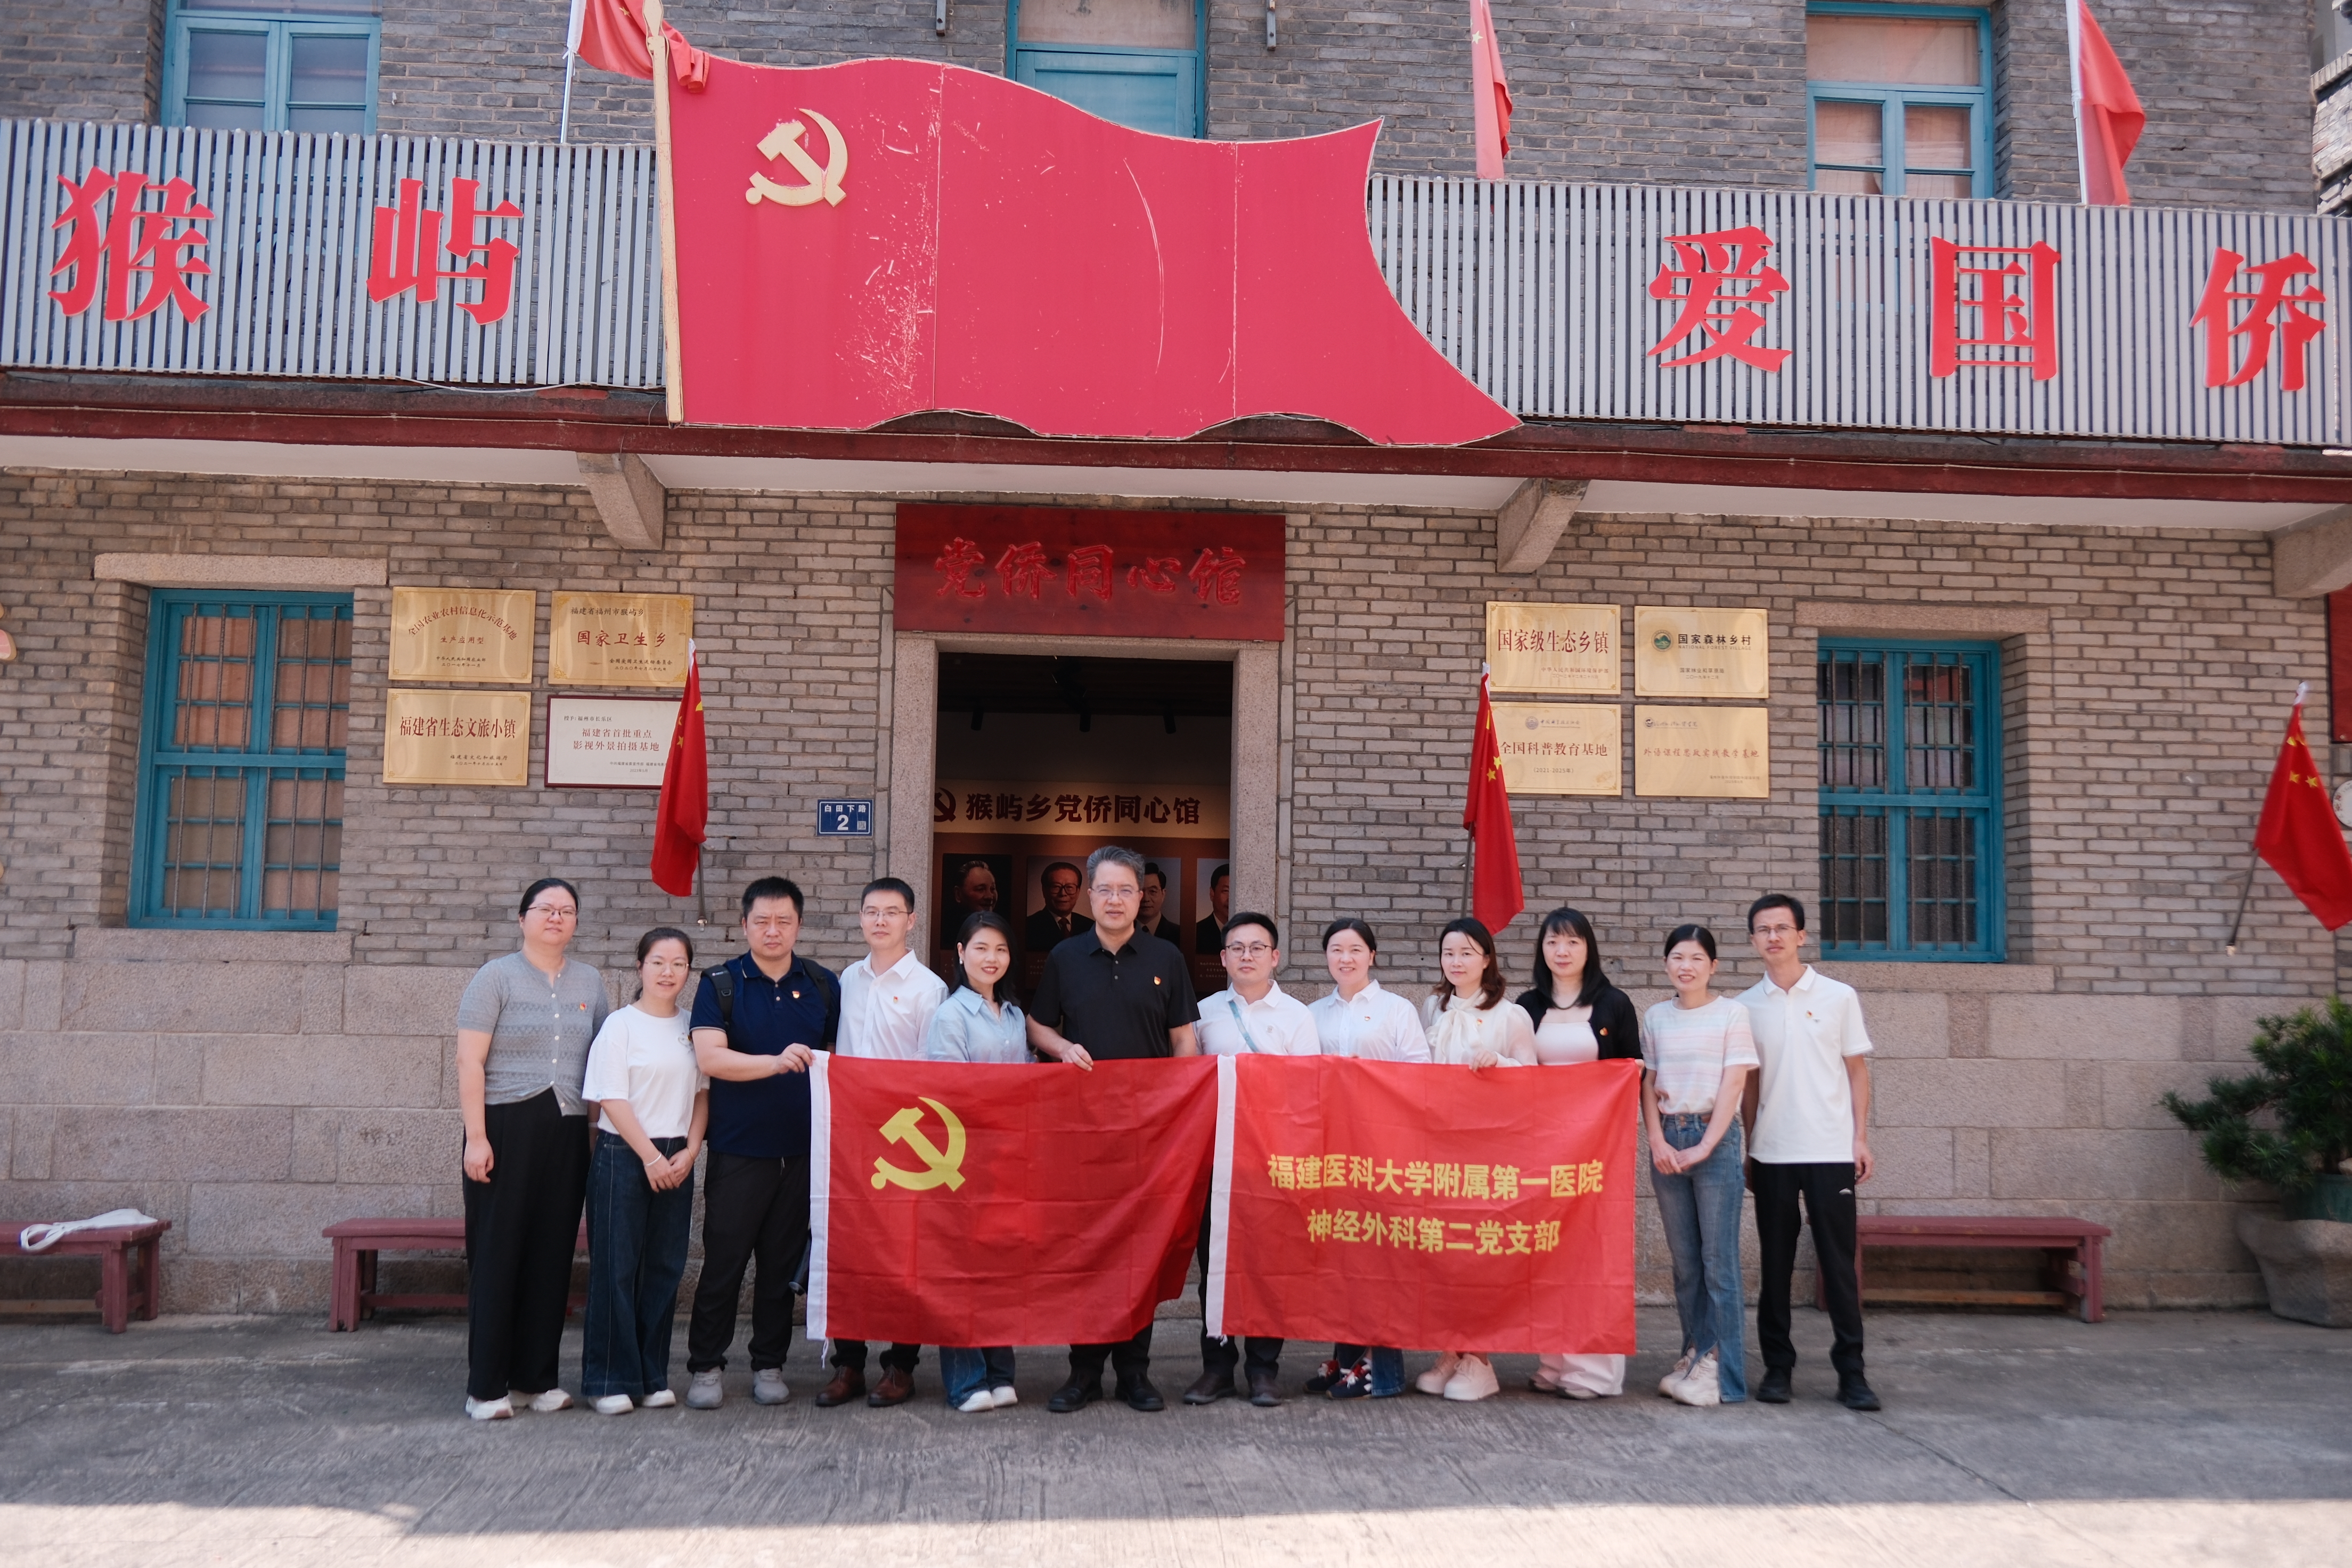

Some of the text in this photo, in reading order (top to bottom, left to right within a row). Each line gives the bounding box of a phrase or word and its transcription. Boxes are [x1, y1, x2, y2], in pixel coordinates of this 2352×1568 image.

[47, 167, 524, 325] 猴屿
[1647, 226, 2326, 391] 爱国侨
[934, 537, 1247, 605] 党侨同心馆
[570, 607, 644, 616] 福建省福州市猴屿乡
[408, 606, 518, 641] 全国农业农村信息化示范基地
[440, 635, 485, 644] 生产应用型
[577, 630, 666, 647] 国家卫生乡
[1498, 628, 1609, 654] 国家级生态乡镇
[1678, 634, 1751, 646] 国家森林乡村
[399, 716, 516, 738] 福建省生态文旅小镇
[581, 728, 652, 738] 福建省首批重点
[573, 740, 660, 752] 影视外景拍摄基地
[1500, 741, 1608, 756] 全国科普教育基地
[966, 793, 1201, 826] 猴屿乡党侨同心馆
[837, 814, 849, 830] 2
[1268, 1153, 1604, 1200] 福建医科大学附属第一医院
[1307, 1208, 1561, 1256] 神经外科第二党支部
